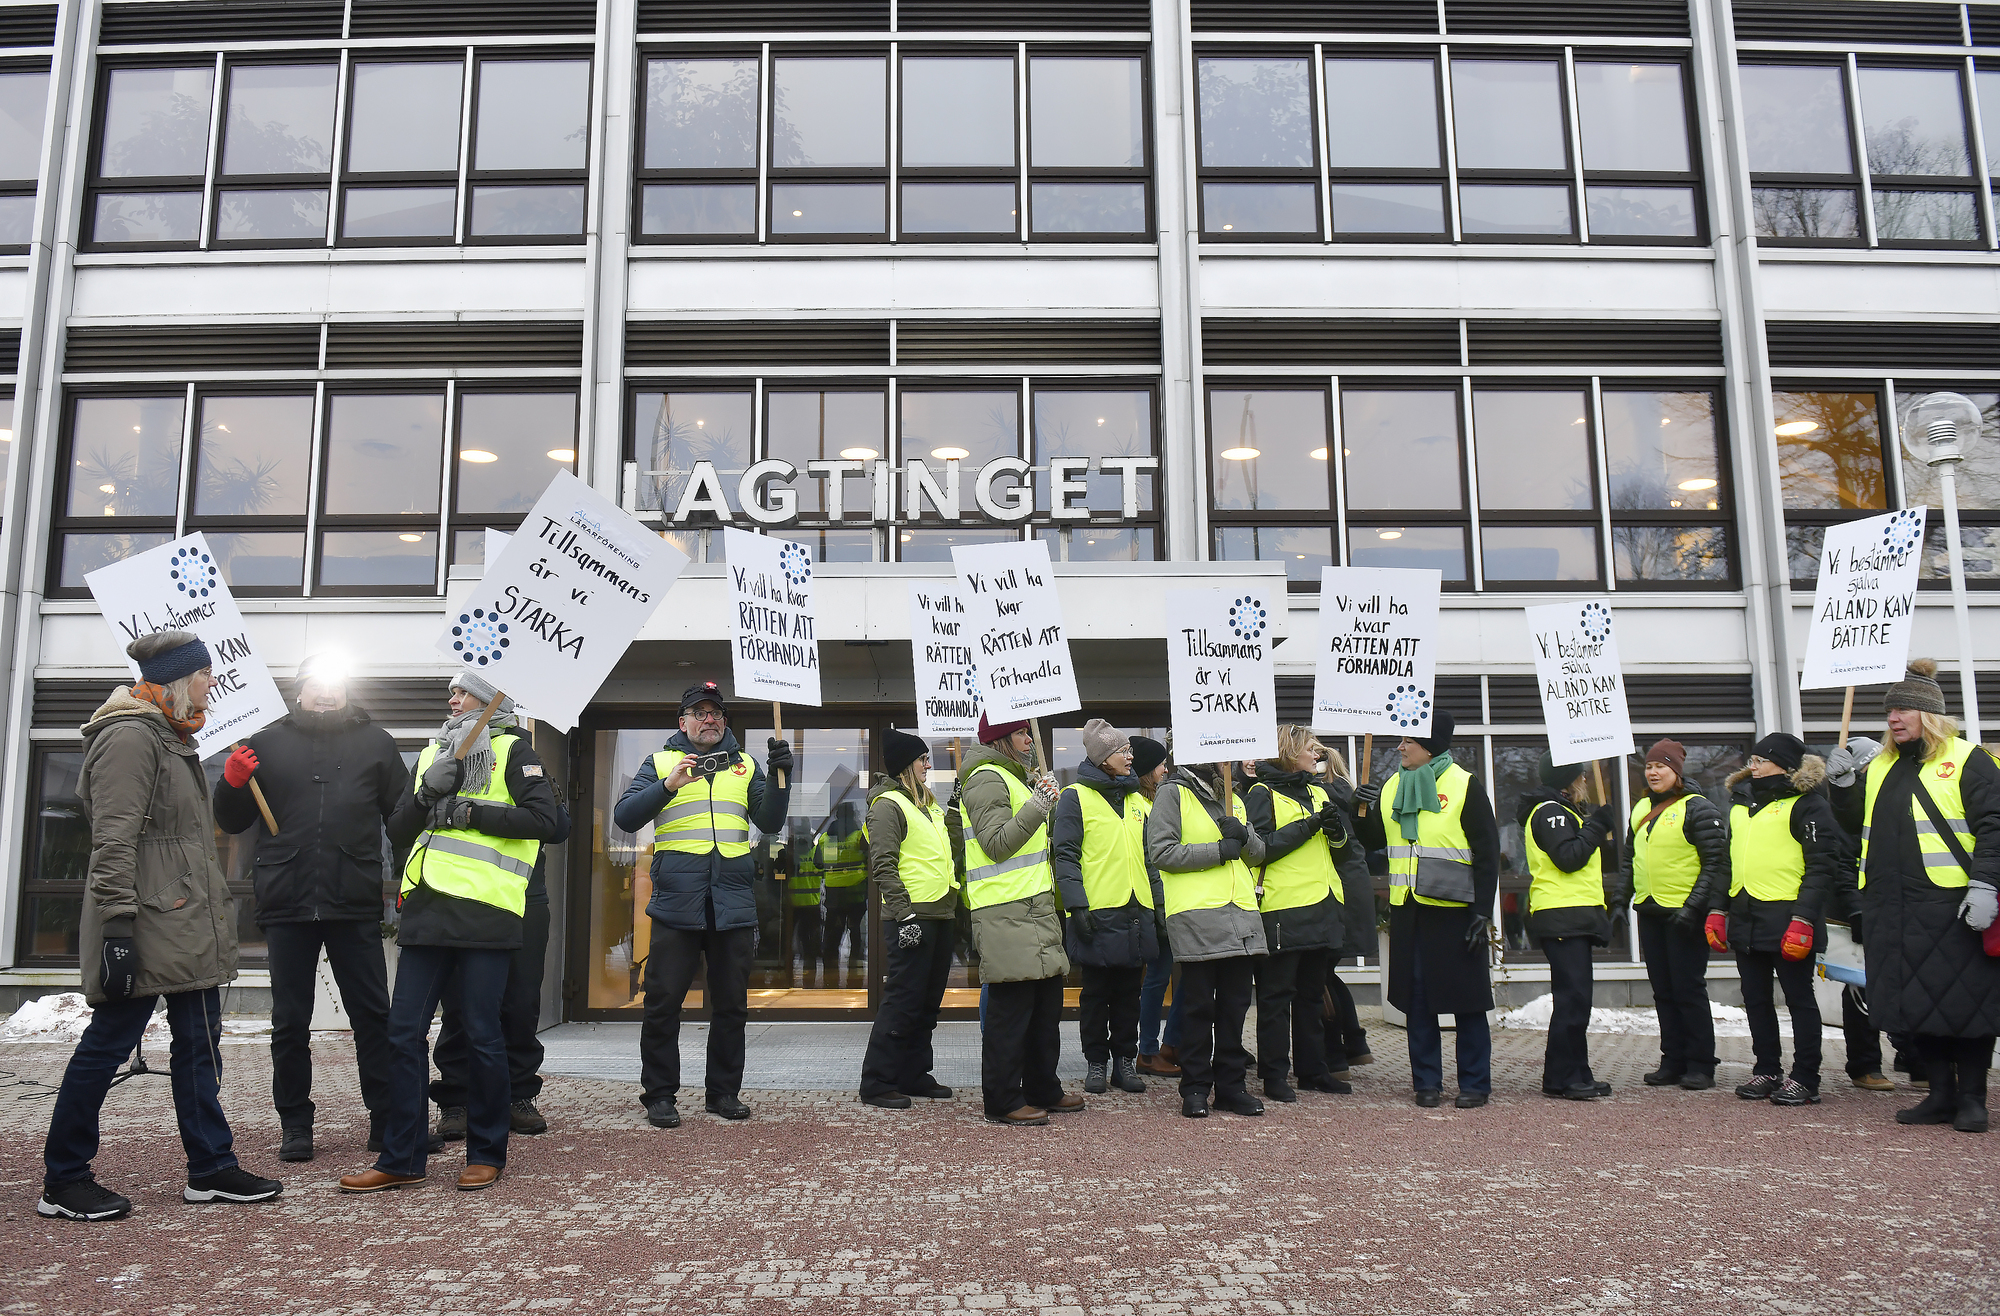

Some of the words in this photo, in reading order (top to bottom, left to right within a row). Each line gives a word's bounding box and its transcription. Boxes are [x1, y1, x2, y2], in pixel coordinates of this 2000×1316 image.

[623, 456, 1159, 526] LAGTINGET
[570, 516, 640, 569] LÄRARFÖRENING
[539, 516, 650, 604] Tillsammans
[1828, 549, 1840, 575] Vi
[1850, 543, 1913, 572] bestämmer
[529, 558, 560, 580] är
[571, 588, 595, 606] vi
[733, 566, 746, 593] Vi
[750, 574, 766, 599] vill
[770, 575, 782, 603] ha
[786, 579, 808, 608] kvar
[967, 572, 987, 594] Vi
[995, 569, 1018, 590] vill
[1025, 568, 1043, 586] ha
[1847, 573, 1879, 598] själva
[918, 593, 930, 610] Vi
[935, 596, 950, 612] vill
[1336, 595, 1352, 612] Vi
[1358, 595, 1380, 614] vill
[1389, 596, 1408, 615] ha
[1821, 597, 1877, 623] ÅLAND
[1883, 592, 1913, 618] KAN
[144, 602, 216, 634] bestämmer
[495, 586, 584, 659] STARKA
[739, 601, 787, 637] RÄTTEN
[793, 614, 814, 640] ATT
[932, 616, 960, 636] kvar
[1354, 617, 1390, 633] kvar
[215, 633, 252, 664] KAN
[981, 628, 1032, 656] RÄTTEN
[1039, 626, 1060, 646] ATT
[1182, 629, 1262, 661] Tillsammans
[1331, 633, 1389, 655] RÄTTEN
[1392, 638, 1420, 656] ATT
[1536, 632, 1551, 659] Vi
[1556, 630, 1604, 660] bestämmer
[1832, 623, 1892, 650] BÄTTRE
[739, 635, 817, 670] FÖRHANDLA
[926, 642, 972, 665] RÄTTEN
[990, 660, 1061, 689] Förhandla
[1196, 667, 1211, 686] är
[1218, 668, 1231, 686] vi
[1337, 656, 1413, 677] FÖRHANDLA
[1562, 660, 1592, 678] själva
[207, 668, 248, 706] TTRE
[755, 678, 800, 688] LÄRARFÖRENING
[939, 672, 962, 690] ATT
[1547, 679, 1588, 701] ÅLAND
[1592, 675, 1616, 694] KAN
[925, 697, 979, 718] FÖRHANDLA
[1011, 696, 1062, 710] LÄRARFÖRENING
[1190, 692, 1259, 714] STARKA
[1319, 706, 1382, 716] LÄRARFÖRENING
[1566, 698, 1612, 719] BÄTTRE
[200, 707, 260, 740] LÄRARFÖRENING
[1200, 738, 1256, 746] LÄRARFÖRENING
[1546, 816, 1565, 828] 77
